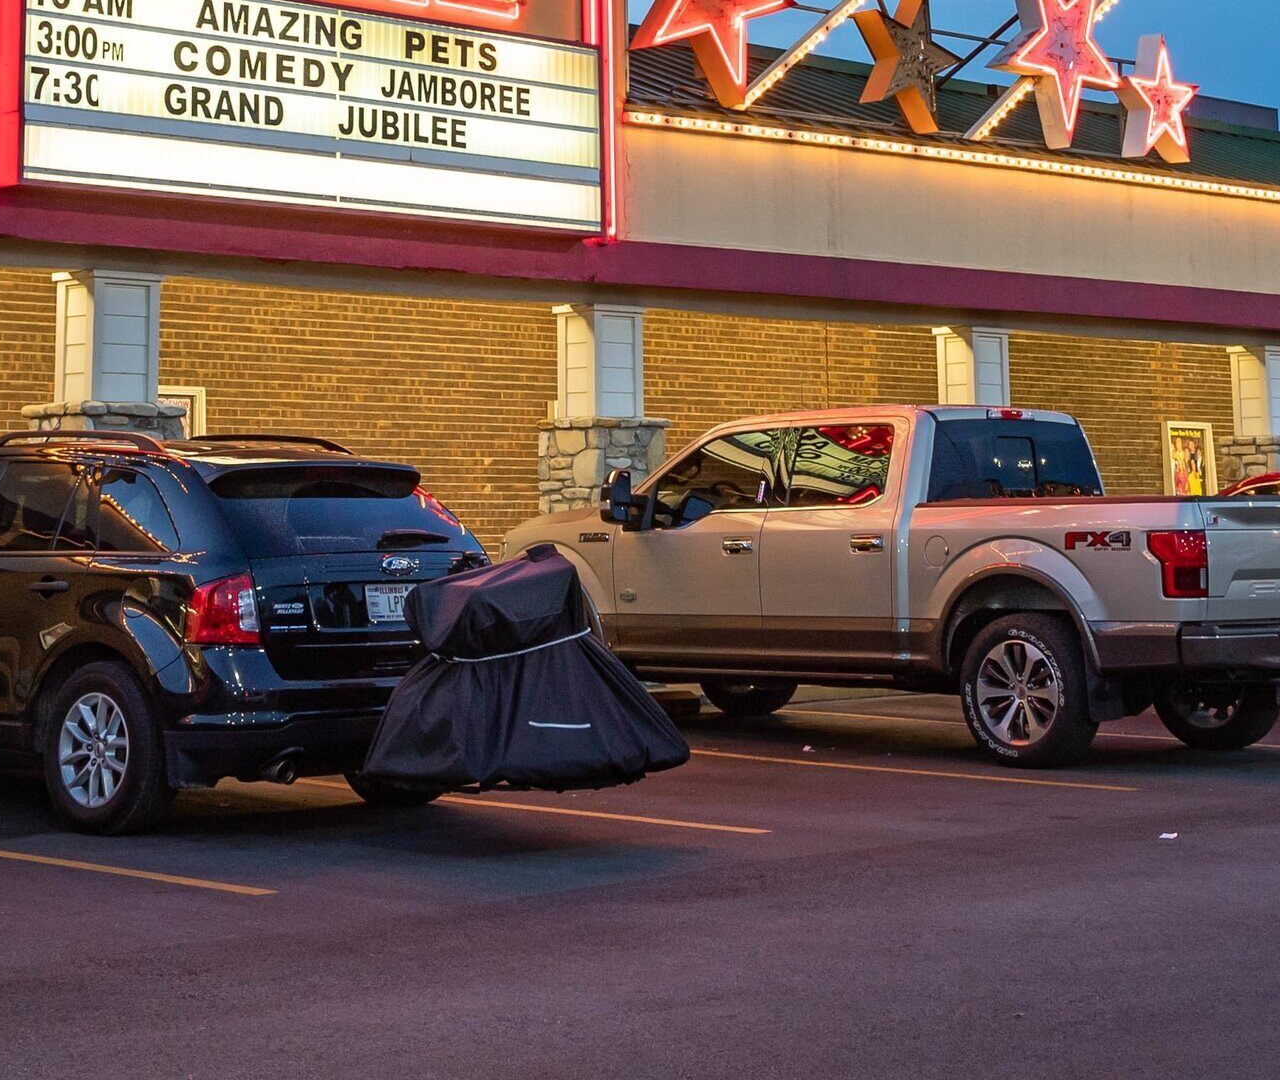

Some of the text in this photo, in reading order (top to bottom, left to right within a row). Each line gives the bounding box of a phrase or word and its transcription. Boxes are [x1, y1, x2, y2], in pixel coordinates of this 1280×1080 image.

[36, 20, 531, 117] 3:00 PM COMEDY JAMBOREE
[404, 30, 498, 71] PETS
[163, 82, 285, 127] GRAND
[338, 105, 468, 150] JUBILEE
[1064, 530, 1132, 551] FX4
